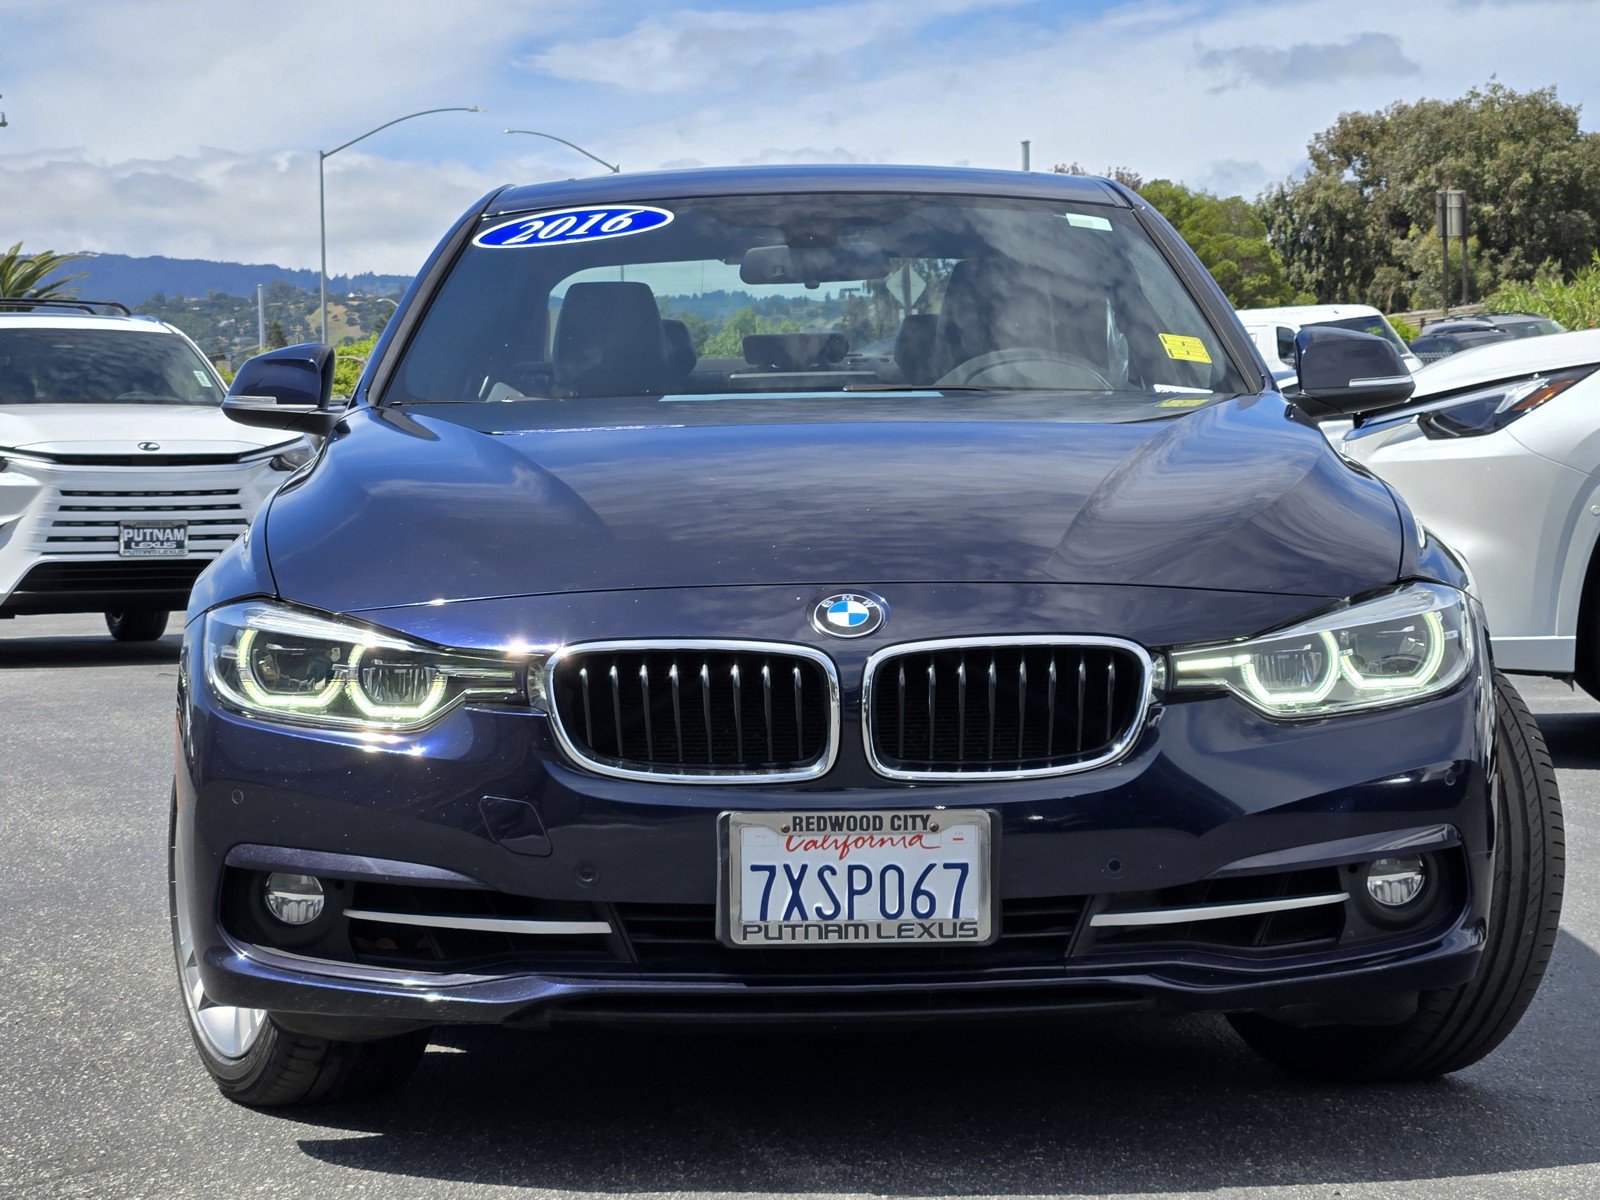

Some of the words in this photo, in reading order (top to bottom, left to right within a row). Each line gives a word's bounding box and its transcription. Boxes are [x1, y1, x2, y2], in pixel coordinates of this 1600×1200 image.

[502, 209, 645, 245] 2016
[123, 528, 184, 541] PUTNAM
[131, 541, 177, 549] LEXUS
[821, 594, 876, 608] BMW
[792, 815, 883, 832] REDWOOD
[890, 814, 931, 831] CITY
[785, 834, 941, 860] California
[750, 862, 969, 921] 7XSP067
[742, 922, 869, 941] PUTNAM
[876, 922, 978, 939] LEXUS
